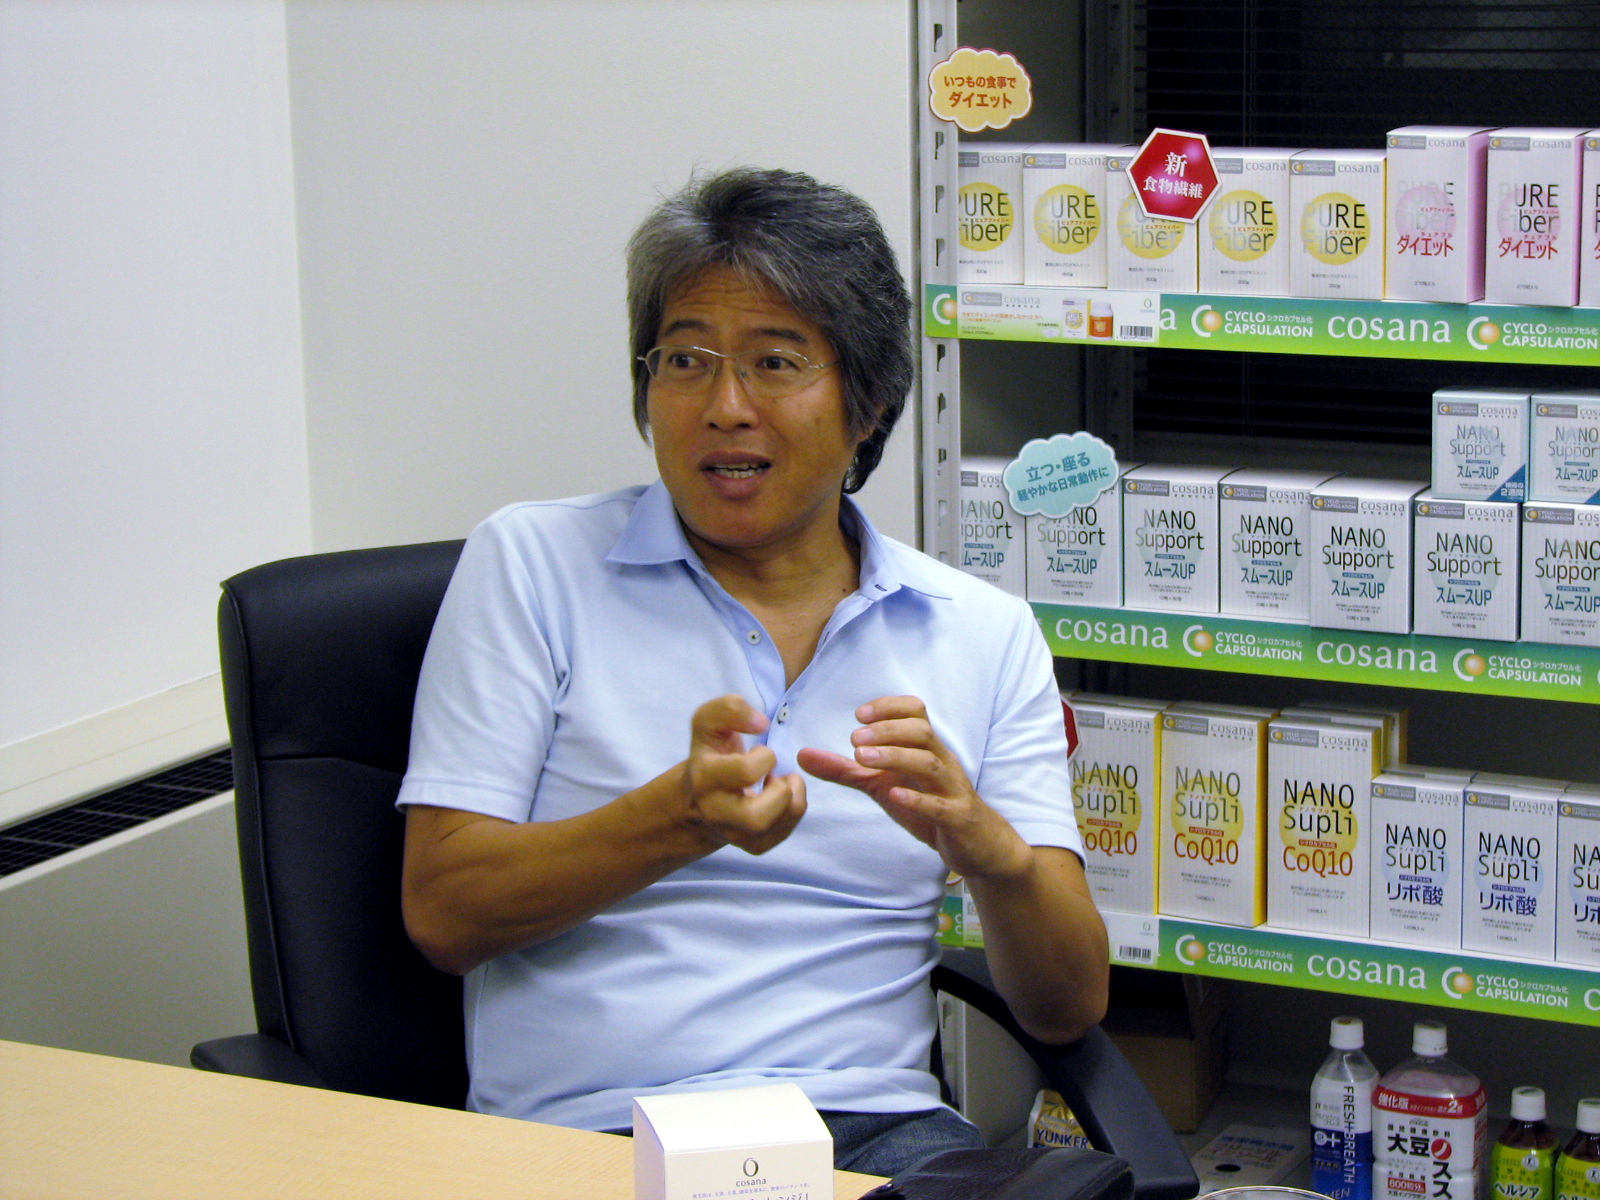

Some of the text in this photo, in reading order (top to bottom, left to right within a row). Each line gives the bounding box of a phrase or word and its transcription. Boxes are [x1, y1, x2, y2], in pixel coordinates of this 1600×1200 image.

[944, 76, 1016, 88] いつもの食事で
[949, 92, 1012, 108] ダイエット
[1428, 139, 1465, 148] cosana
[1532, 139, 1571, 149] cosana
[982, 154, 1020, 164] cosana
[1068, 156, 1108, 166] cosana
[1164, 152, 1188, 178] 新
[1245, 161, 1286, 171] cosana
[1338, 163, 1380, 173] cosana
[1142, 176, 1204, 199] 食物繊維
[959, 218, 1010, 242] iber
[1397, 234, 1454, 257] ダイエット
[1499, 237, 1558, 260] ダイエット
[1225, 310, 1313, 324] CYCLO シクロカプセル化
[1225, 323, 1313, 338] CAPSULATION
[1327, 315, 1451, 344] cosana
[1502, 322, 1599, 336] CYCLO シクロカプセル化
[1502, 335, 1598, 350] CAPSULATION
[1480, 407, 1518, 415] cosana
[1457, 424, 1499, 440] NANO
[1556, 426, 1599, 443] NANO
[1450, 439, 1506, 458] Support
[1026, 452, 1090, 482] 立つ・座る
[1457, 465, 1499, 479] スムースUP
[1555, 467, 1598, 482] スムースUP
[1017, 467, 1109, 501] 軽やかな日常動作に
[1172, 484, 1214, 495] cosana
[961, 500, 1004, 519] ANO
[1361, 502, 1404, 512] cosana
[1468, 507, 1513, 518] cosana
[1143, 509, 1196, 530] NANO
[1240, 515, 1293, 536] NANO
[1038, 524, 1106, 548] Support
[1136, 527, 1205, 552] Support
[1232, 533, 1302, 558] Support
[1331, 526, 1386, 549] NANO
[1436, 532, 1493, 555] NANO
[962, 551, 1004, 568] ムースUP
[1047, 556, 1097, 575] スムースUP
[1322, 544, 1394, 570] Support
[1427, 552, 1502, 577] Support
[1145, 561, 1196, 580] スムースUP
[1241, 567, 1293, 586] スムースUP
[1331, 580, 1385, 599] スムースUP
[1436, 587, 1492, 606] スムースUP
[1055, 618, 1168, 649] cosana
[1216, 632, 1302, 648] CYCLO シクロカプセル化
[1216, 644, 1302, 661] CAPSULATION
[1317, 641, 1437, 673] cosana
[1488, 655, 1582, 673] CYCLO シクロカプセル化
[1488, 668, 1582, 686] CAPSULATION
[1107, 716, 1150, 729] cosana
[1210, 724, 1254, 737] cosana
[1322, 736, 1368, 747] cosana
[1073, 759, 1138, 790] NANO
[1175, 765, 1240, 798] NANO
[1073, 784, 1136, 818] Supli
[1284, 779, 1354, 809] NANO
[1418, 791, 1459, 802] cosana
[1175, 792, 1239, 826] Supli
[1512, 800, 1554, 813] cosana
[1283, 805, 1352, 838] Supli
[1077, 825, 1137, 857] oQ10
[1386, 823, 1446, 850] NANO
[1479, 832, 1540, 859] NANO
[1174, 833, 1239, 865] CoQ10
[1283, 846, 1353, 878] CoQ10
[1386, 846, 1444, 875] Supli
[1479, 854, 1538, 884] Supli
[1387, 882, 1443, 906] リポ酸
[1479, 891, 1537, 917] リポ酸
[1208, 941, 1292, 960] CYCLO シクロカプセル化
[1208, 954, 1293, 973] CAPSULATION
[1307, 955, 1426, 989] cosana
[1476, 974, 1568, 994] CYCLO シクロカプセル化
[1476, 987, 1568, 1007] CAPSULATION
[1378, 1092, 1409, 1110] 強化版
[1037, 1129, 1088, 1148] YUNKER
[1387, 1133, 1430, 1157] 大豆
[736, 1178, 766, 1187] cosana
[1495, 1182, 1540, 1198] ヘルシア
